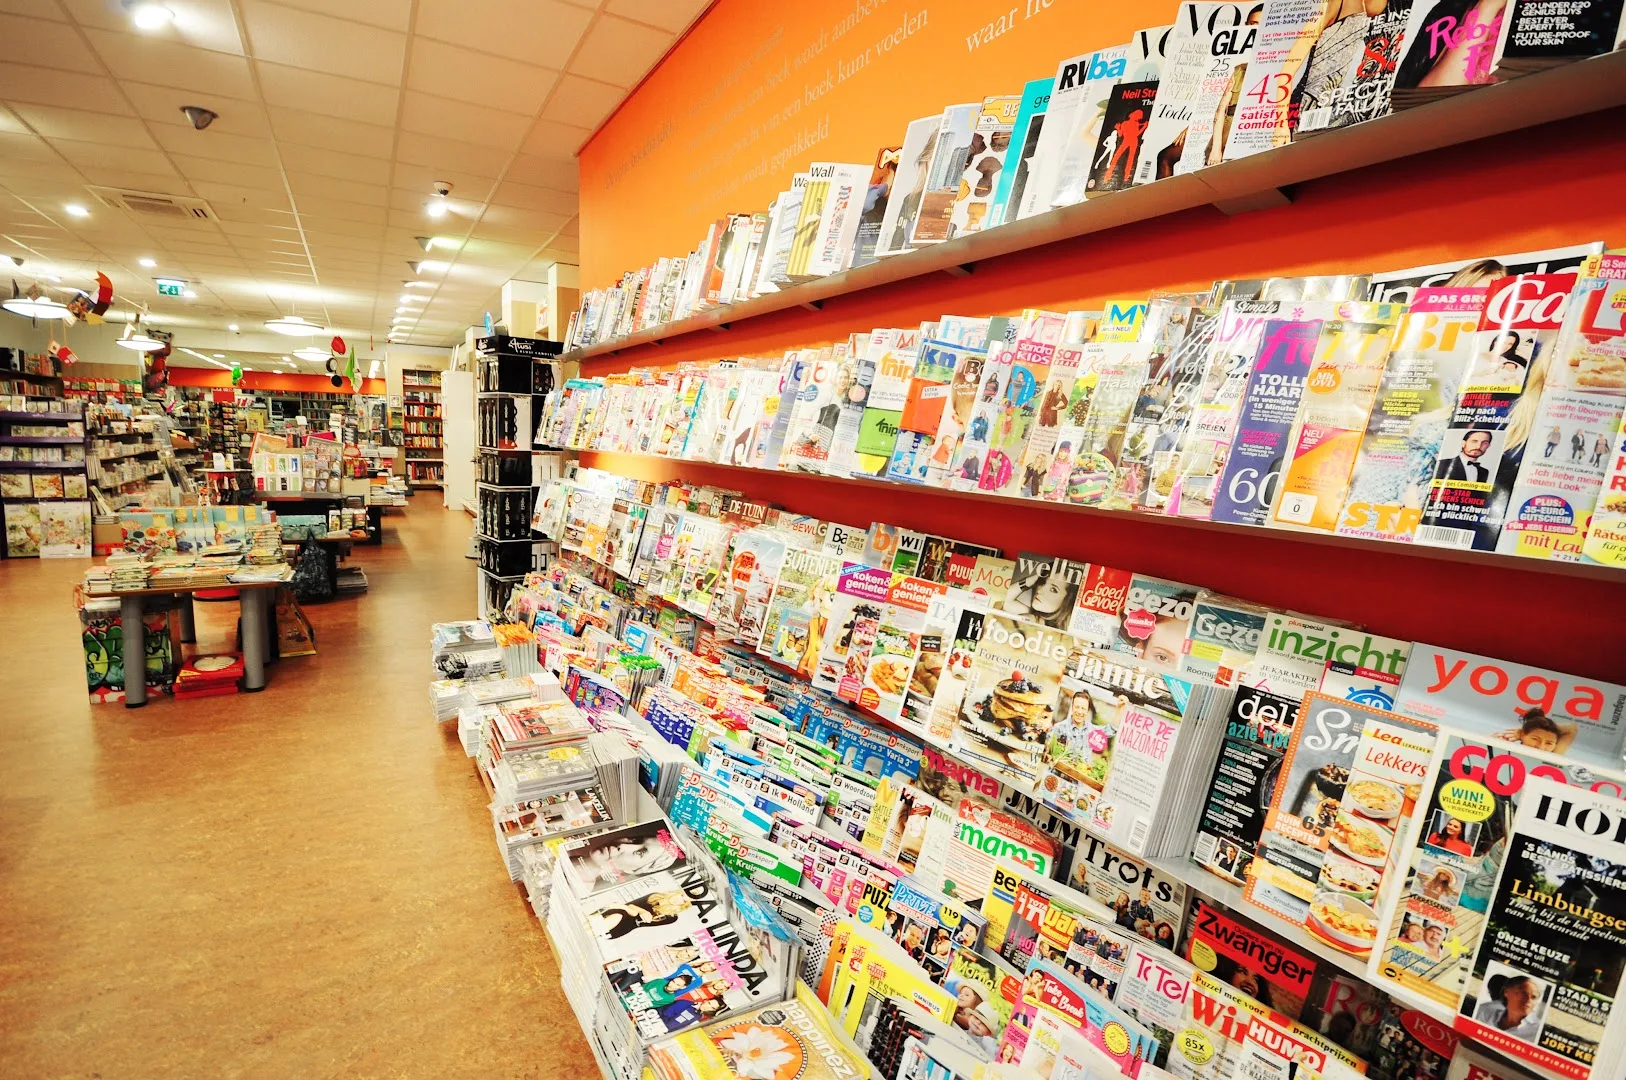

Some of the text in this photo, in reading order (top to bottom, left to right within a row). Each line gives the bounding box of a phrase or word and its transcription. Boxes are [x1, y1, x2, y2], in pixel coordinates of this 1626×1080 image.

[1556, 8, 1582, 16] BUYS
[965, 5, 1018, 53] waar
[1265, 18, 1300, 27] post-baby
[1517, 23, 1554, 31] EXPERT
[1515, 31, 1591, 39] FUTURE-PROOF
[1541, 38, 1565, 46] SKIN
[804, 68, 835, 107] boek
[837, 48, 871, 85] kunt
[875, 9, 928, 58] voelen
[1211, 58, 1230, 71] 25
[1202, 78, 1234, 86] GUAPA
[1247, 72, 1294, 104] 43
[1122, 90, 1140, 100] Neil
[1240, 109, 1285, 122] satisfy
[1237, 120, 1285, 130] comfort
[770, 116, 830, 176] geprikkeld
[810, 166, 835, 178] Wall
[1601, 259, 1610, 267] 16
[1235, 300, 1278, 314] Simply
[1428, 295, 1460, 304] DAS
[1443, 304, 1466, 312] ALLE
[1020, 342, 1053, 355] sandra
[1017, 351, 1051, 365] KIDS
[1311, 378, 1336, 389] DVD
[1253, 402, 1263, 410] 15
[1264, 396, 1296, 407] weniger
[1457, 407, 1476, 415] Baby
[1569, 413, 1599, 423] Energie
[1578, 405, 1613, 416] Übungen
[1303, 428, 1325, 439] NEU
[1526, 478, 1556, 487] neuen
[1552, 470, 1575, 480] liebe
[1457, 482, 1491, 490] Coming-out
[729, 499, 767, 519] DE TUIN
[1293, 504, 1301, 513] 0
[1446, 503, 1460, 511] bin
[1461, 505, 1490, 514] schwul
[1461, 497, 1485, 505] SCHICK
[1535, 497, 1562, 507] PLUS:
[1442, 510, 1478, 522] glücklich
[1520, 513, 1572, 524] GUTSCHEIN
[1524, 506, 1570, 516] 35-EURO-
[1508, 522, 1523, 530] FÜR
[1524, 523, 1543, 532] JEDE
[1524, 533, 1549, 548] mit
[1094, 581, 1126, 599] Goed
[1081, 591, 1124, 613] Gevoel
[985, 617, 1068, 662] foodie
[1267, 619, 1407, 676] inzicht
[979, 649, 1040, 675] Forest food
[1067, 644, 1165, 699] jamie
[1272, 667, 1317, 683] KARAKTER
[1268, 673, 1281, 681] vijf
[1282, 678, 1315, 689] woorden
[1426, 654, 1605, 721] yoga
[1610, 694, 1625, 726] magazine
[1124, 711, 1176, 740] VIER DE
[1229, 721, 1258, 742] azie
[860, 739, 878, 751] Varia
[1118, 726, 1168, 762] NAZOMER
[1372, 728, 1403, 745] Lea
[887, 744, 904, 762] Varia
[888, 737, 920, 756] Denksport
[1365, 747, 1428, 778] Lekkers
[923, 748, 1000, 799] mama
[771, 786, 815, 816] Ik Holland
[1441, 795, 1491, 812] VILLA AAN ZEE
[1451, 787, 1484, 804] WIN!
[1592, 801, 1610, 811] HET
[1274, 821, 1320, 846] RECEPTEN
[1277, 813, 1326, 837] RUIM 65
[738, 846, 775, 866] Denksport
[960, 822, 1046, 875] mama
[1539, 844, 1577, 865] LANDS
[1085, 835, 1174, 902] Trots
[1520, 850, 1558, 871] BESTE
[891, 882, 937, 917] PRIVÉ
[1512, 878, 1626, 930] Limburgse
[944, 907, 959, 918] 119
[1509, 897, 1538, 913] Thuis
[1540, 907, 1555, 921] bij
[1557, 913, 1570, 925] de
[1504, 906, 1590, 942] van Amstenrade
[1198, 910, 1313, 984] Zwanger
[1495, 938, 1545, 962] Het beste uit
[1496, 931, 1571, 964] ONZE KEUZE
[706, 921, 768, 996] LINDA.
[1493, 947, 1522, 962] theater
[1532, 961, 1559, 976] musea
[1043, 979, 1064, 995] Take
[1156, 965, 1190, 1004] Tel
[912, 991, 941, 1013] OMNIBUS
[1558, 986, 1599, 1008] STAD &
[1058, 997, 1084, 1018] Break
[1194, 975, 1358, 1069] Puzzel mee voor prachtprijzen
[784, 999, 854, 1080] happinez
[1185, 1038, 1205, 1052] 85x
[1248, 1021, 1320, 1070] HUMO
[1542, 1038, 1573, 1054] JORT
[1477, 1028, 1580, 1074] BOORDEVOL INSPIRATIE
